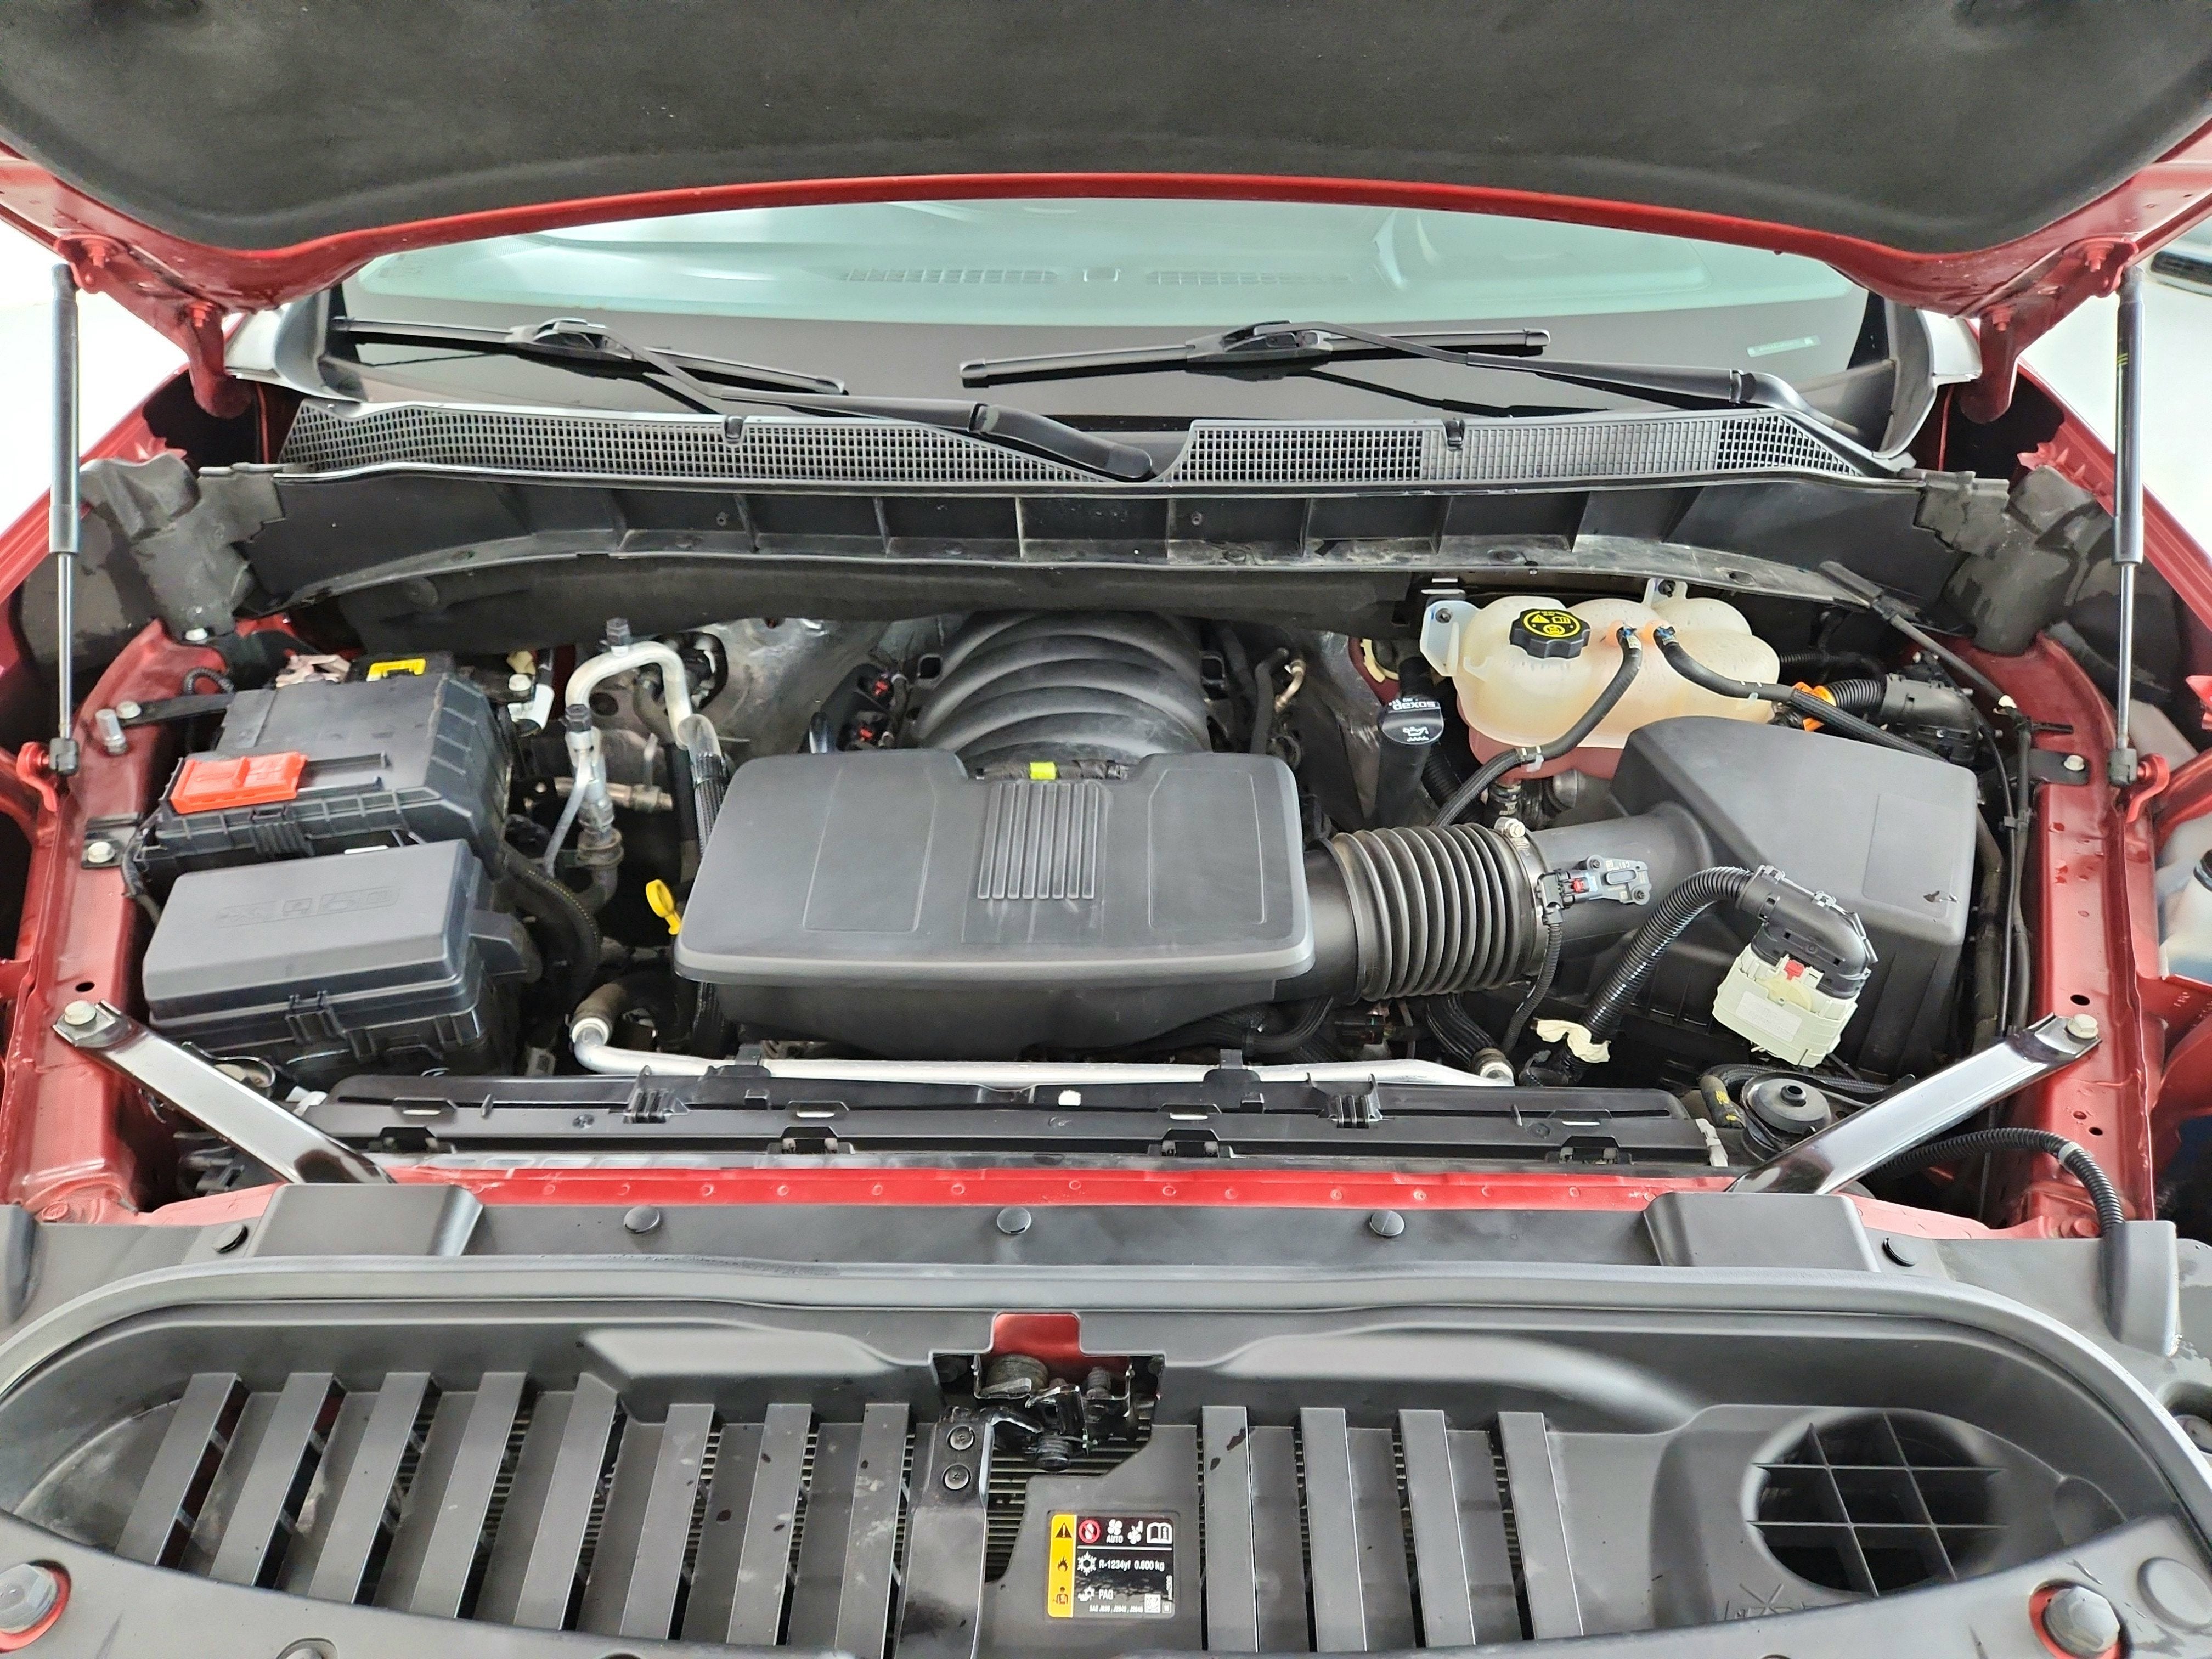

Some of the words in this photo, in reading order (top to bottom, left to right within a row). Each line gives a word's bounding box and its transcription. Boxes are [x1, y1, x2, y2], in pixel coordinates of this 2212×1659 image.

[1393, 699, 1436, 710] dexos
[1106, 1535, 1124, 1543] AUTO
[1099, 1559, 1131, 1571] R-1234yf
[1134, 1560, 1154, 1570] 0.600
[1155, 1560, 1165, 1572] kg
[1098, 1589, 1114, 1600] PAG
